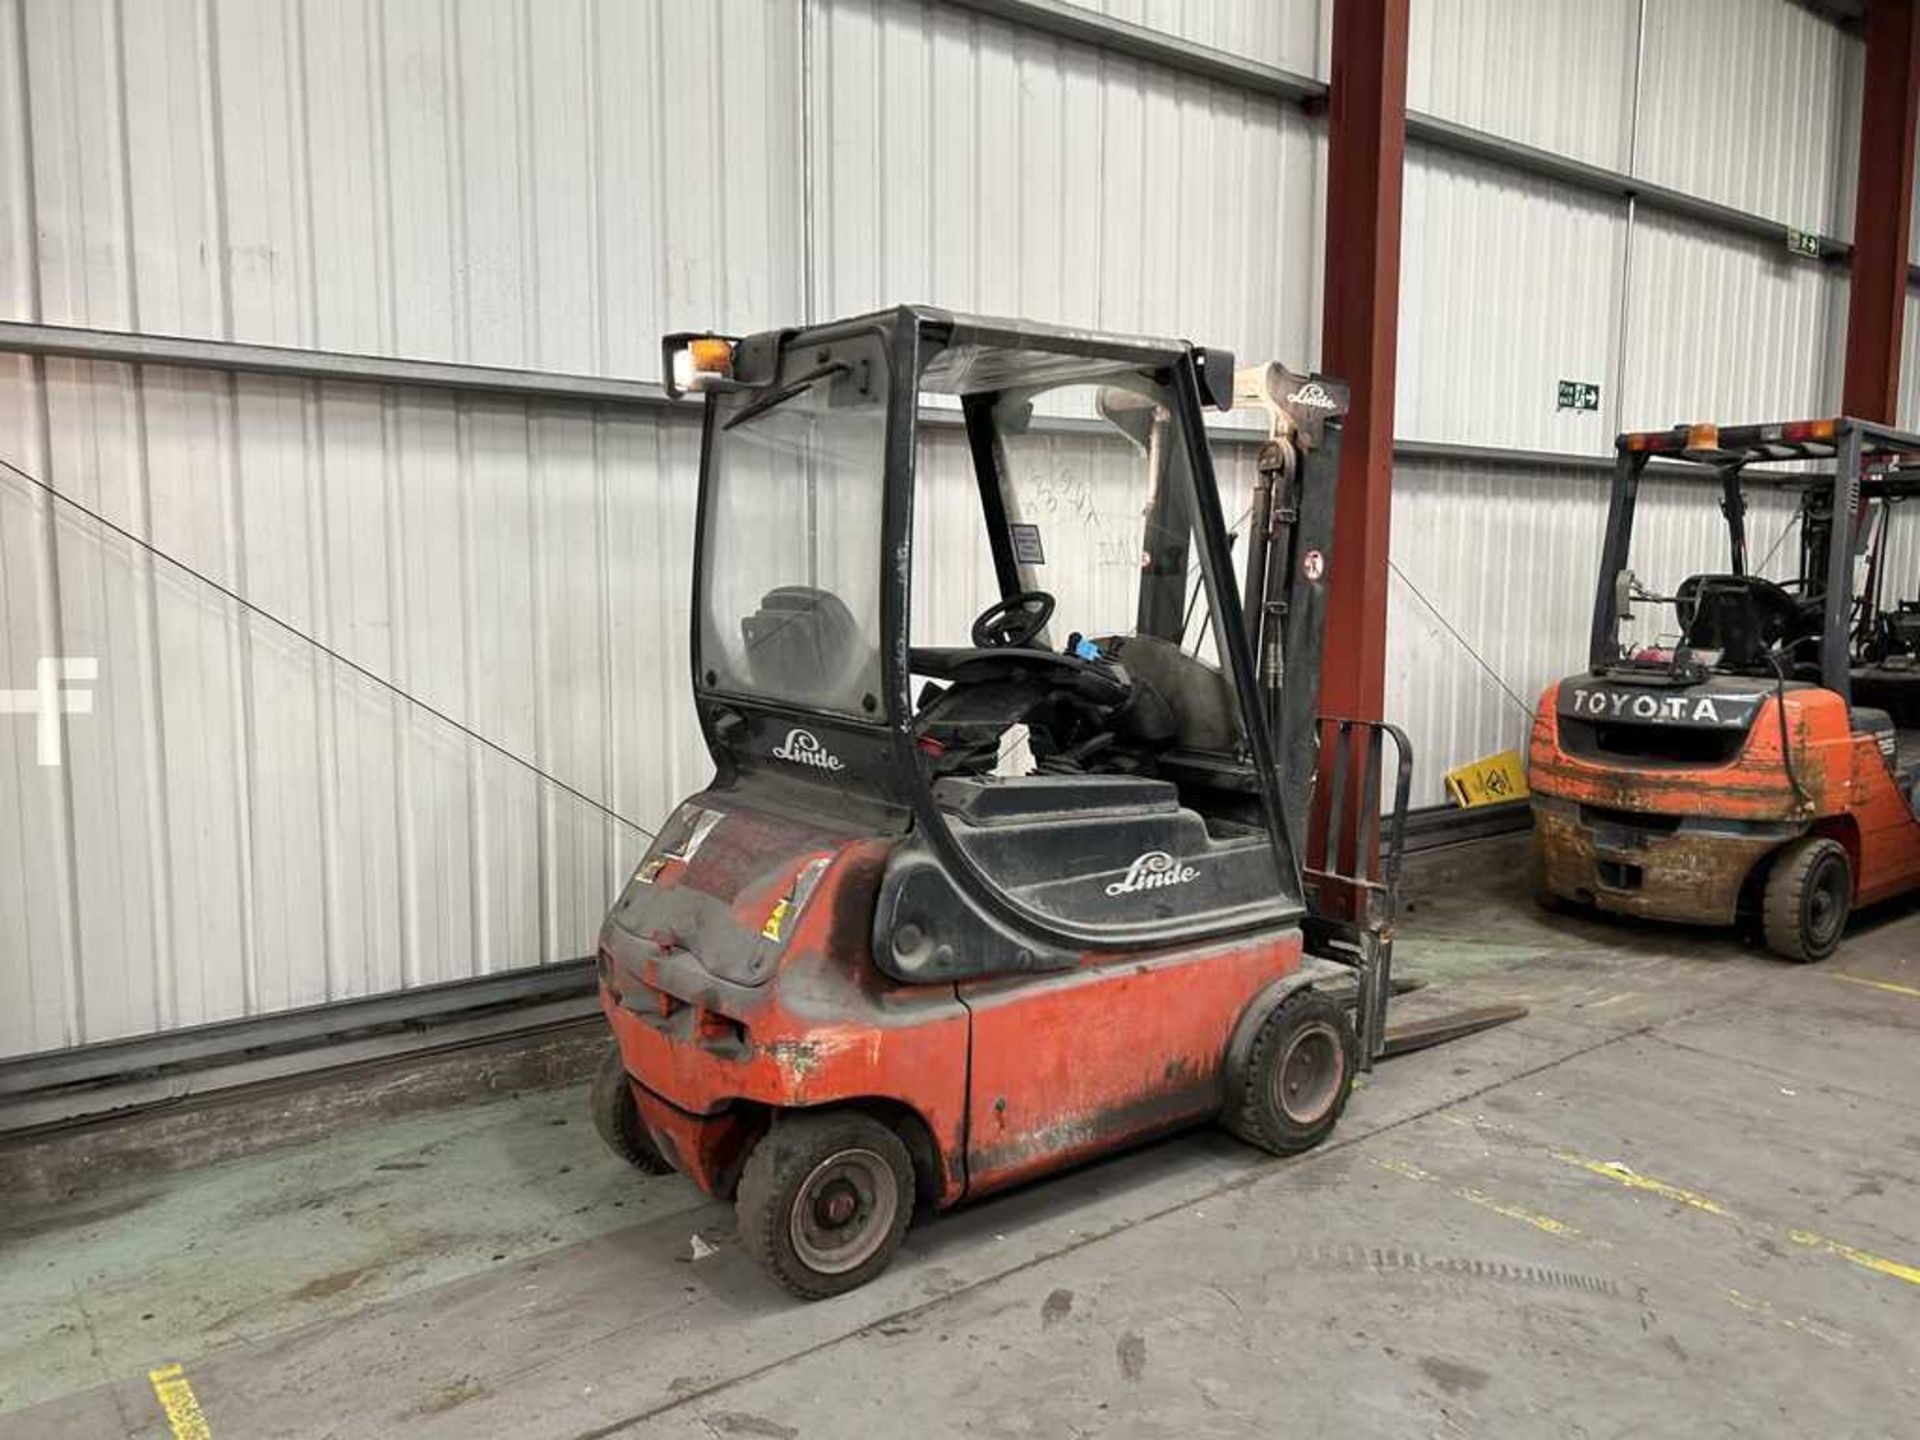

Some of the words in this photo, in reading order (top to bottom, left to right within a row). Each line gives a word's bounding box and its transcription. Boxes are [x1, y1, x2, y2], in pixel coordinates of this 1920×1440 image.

[1286, 383, 1337, 410] Linde
[1574, 689, 1719, 722] TOYOTA
[772, 728, 847, 771] Linde
[1105, 850, 1201, 896] Linde
